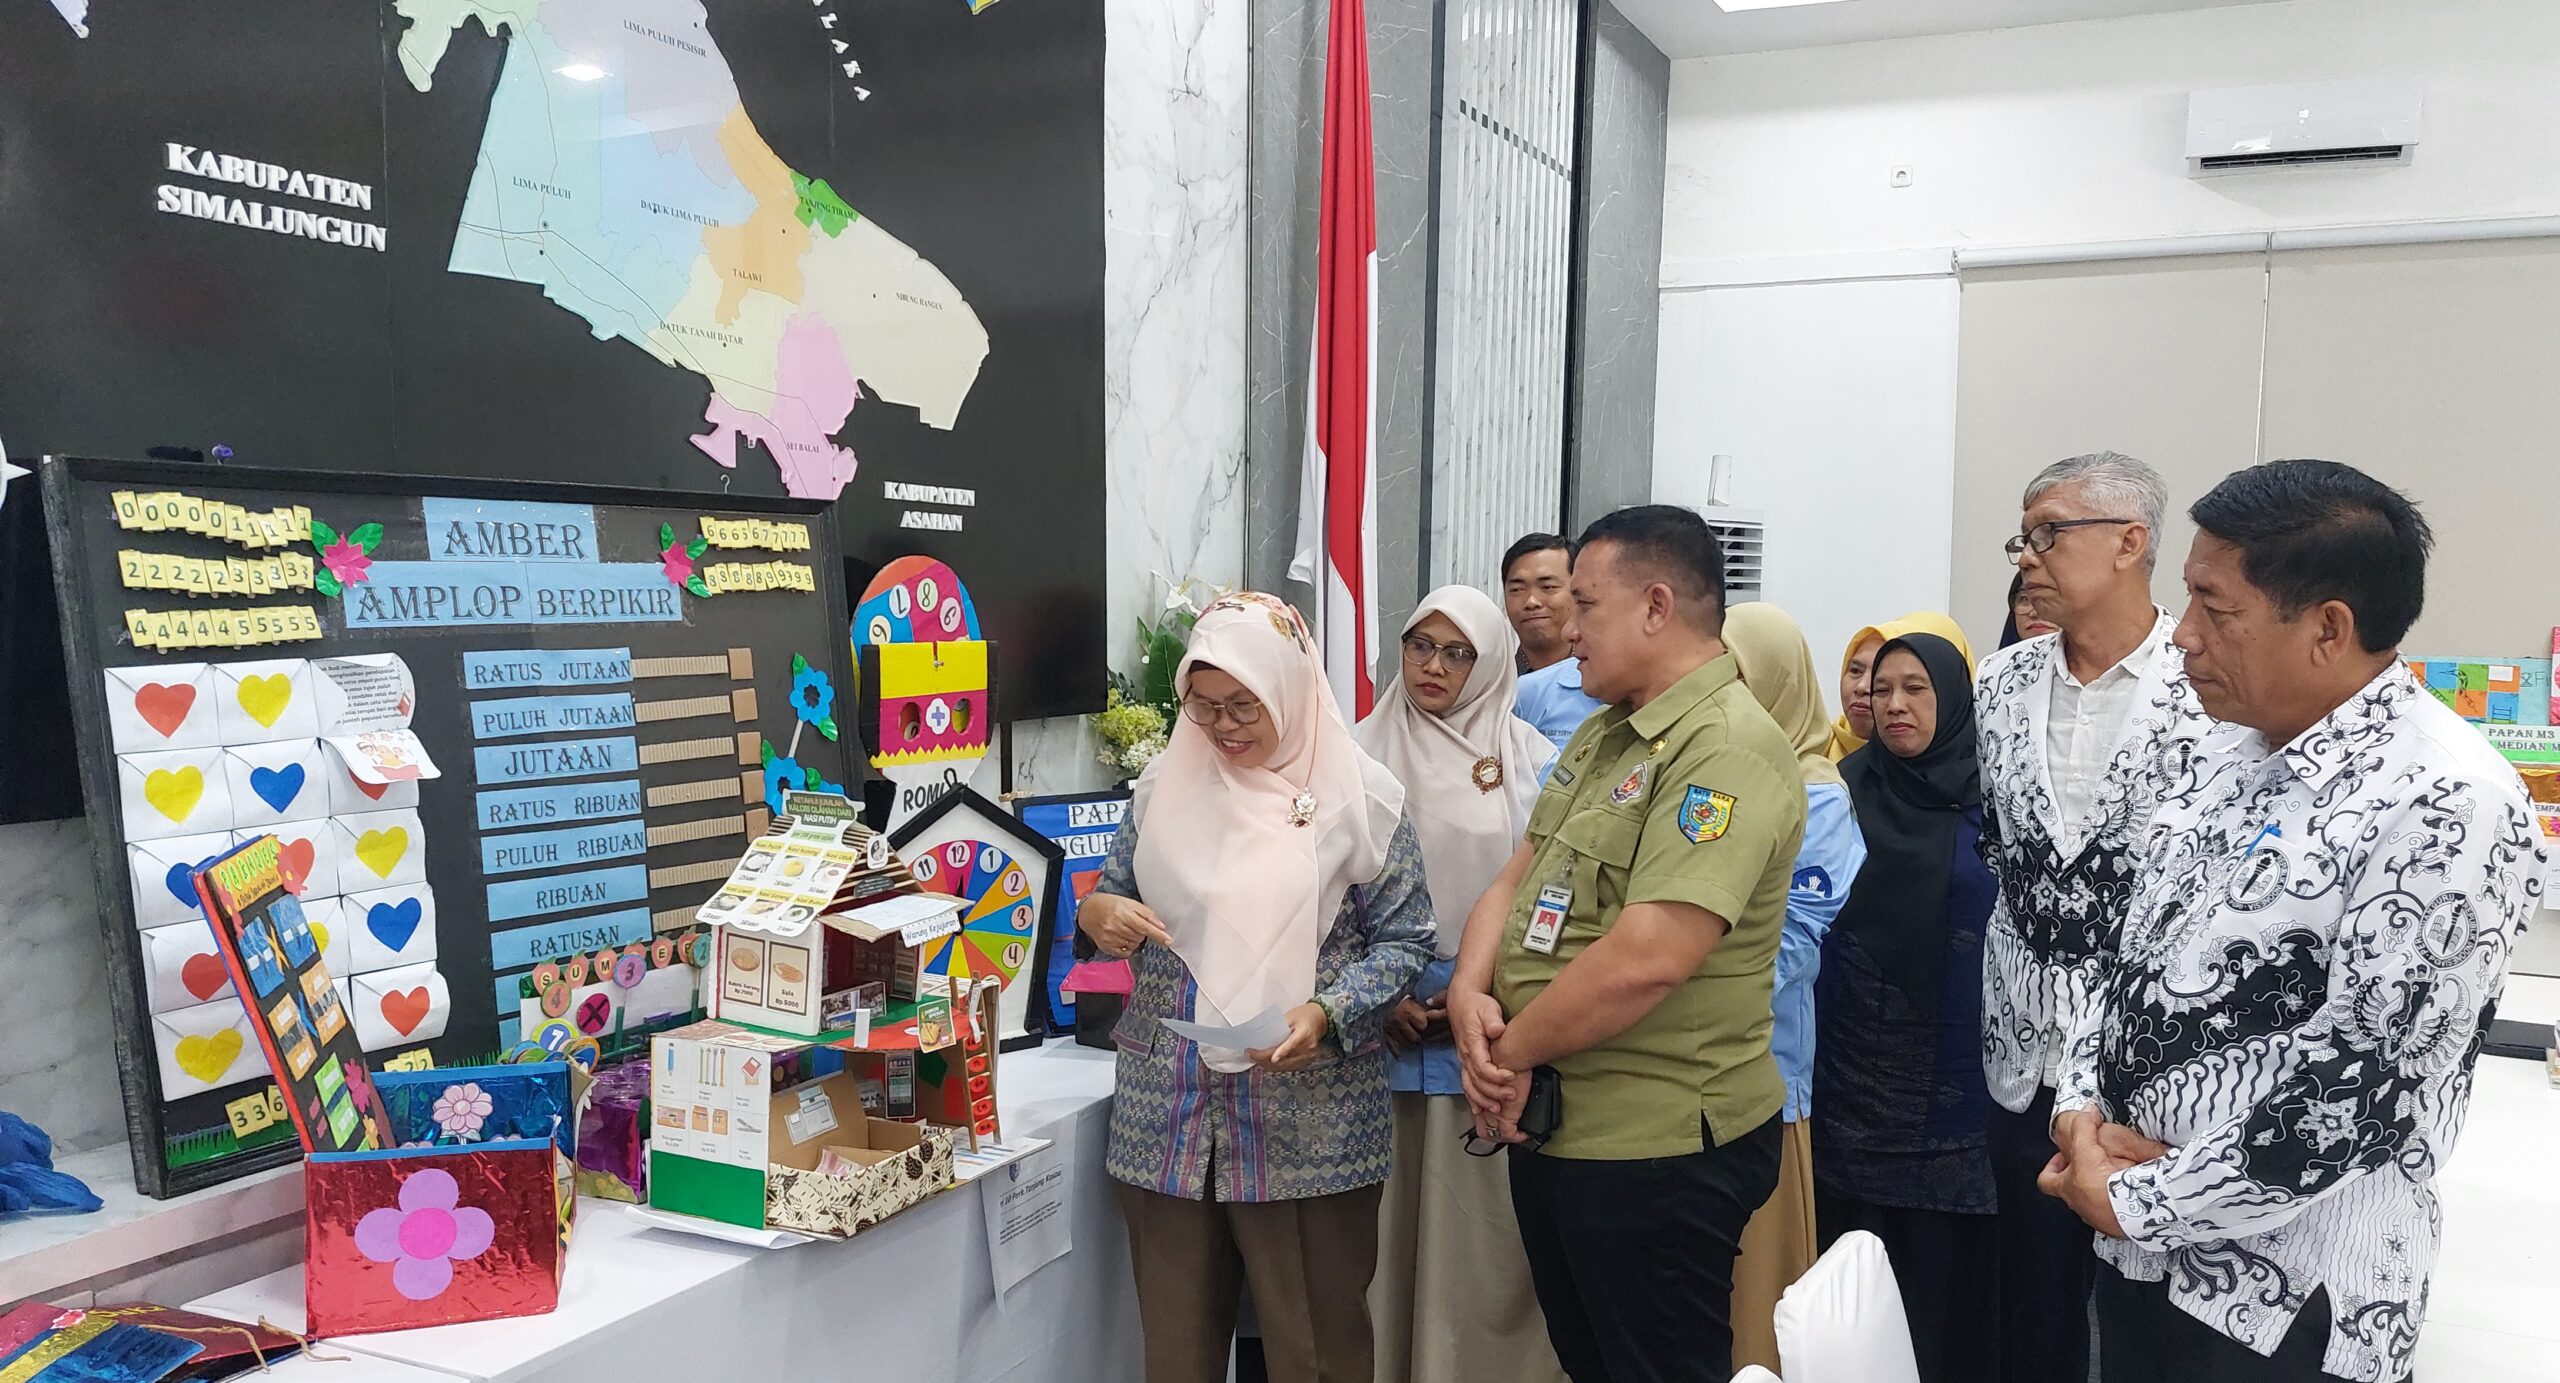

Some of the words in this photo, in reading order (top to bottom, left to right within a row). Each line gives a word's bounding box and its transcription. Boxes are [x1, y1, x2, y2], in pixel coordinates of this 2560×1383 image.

[624, 19, 646, 36] LIMA
[648, 28, 675, 48] PULUH
[677, 39, 707, 58] PESISIR
[165, 141, 373, 212] KABUPATEN
[513, 176, 538, 192] LIMA
[540, 184, 571, 200] PULUH
[157, 183, 387, 252] SIMALUNGUN
[640, 199, 669, 216] DATUK
[671, 207, 692, 220] LIMA
[693, 213, 719, 228] PULUH
[800, 197, 831, 215] TANJUNG
[832, 204, 854, 220] TIRAM
[733, 267, 762, 283] TALAWI
[660, 321, 687, 335] DATUK
[690, 327, 716, 339] TANAH
[717, 332, 743, 345] DATAR
[786, 442, 798, 450] SEI
[799, 443, 819, 454] BALAI
[884, 481, 976, 507] KABUPATEN
[900, 510, 963, 532] ASAHAN
[444, 519, 589, 560] AMBER
[357, 585, 521, 622] AMPLOP
[539, 588, 677, 618] BERPIKIR
[922, 582, 931, 607] 8
[474, 662, 542, 684] RATUS
[558, 659, 633, 681] JUTAAN
[483, 709, 547, 733] PULUH
[559, 704, 633, 726] JUTAAN
[2488, 728, 2533, 739] PAPAN
[2536, 730, 2556, 740] M3
[2497, 741, 2546, 751] MEDIAN
[505, 744, 612, 776] JUTAAN
[489, 799, 556, 824] RATUS
[575, 791, 640, 815] RIBUAN
[804, 813, 819, 823] NASI
[819, 815, 837, 825] PUTIH
[1071, 802, 1128, 826] PAP
[495, 844, 558, 868] PULUH
[578, 832, 645, 858] RIBUAN
[951, 845, 966, 864] 12
[988, 850, 994, 869] 1
[918, 858, 932, 878] 11
[1011, 873, 1019, 892] 2
[536, 882, 607, 910] RIBUAN
[2431, 893, 2455, 909] GURU
[1017, 907, 1026, 928] 3
[529, 925, 620, 959] RATUSAN
[905, 929, 928, 940] Warung
[1009, 945, 1018, 964] 4
[625, 962, 635, 981] 3
